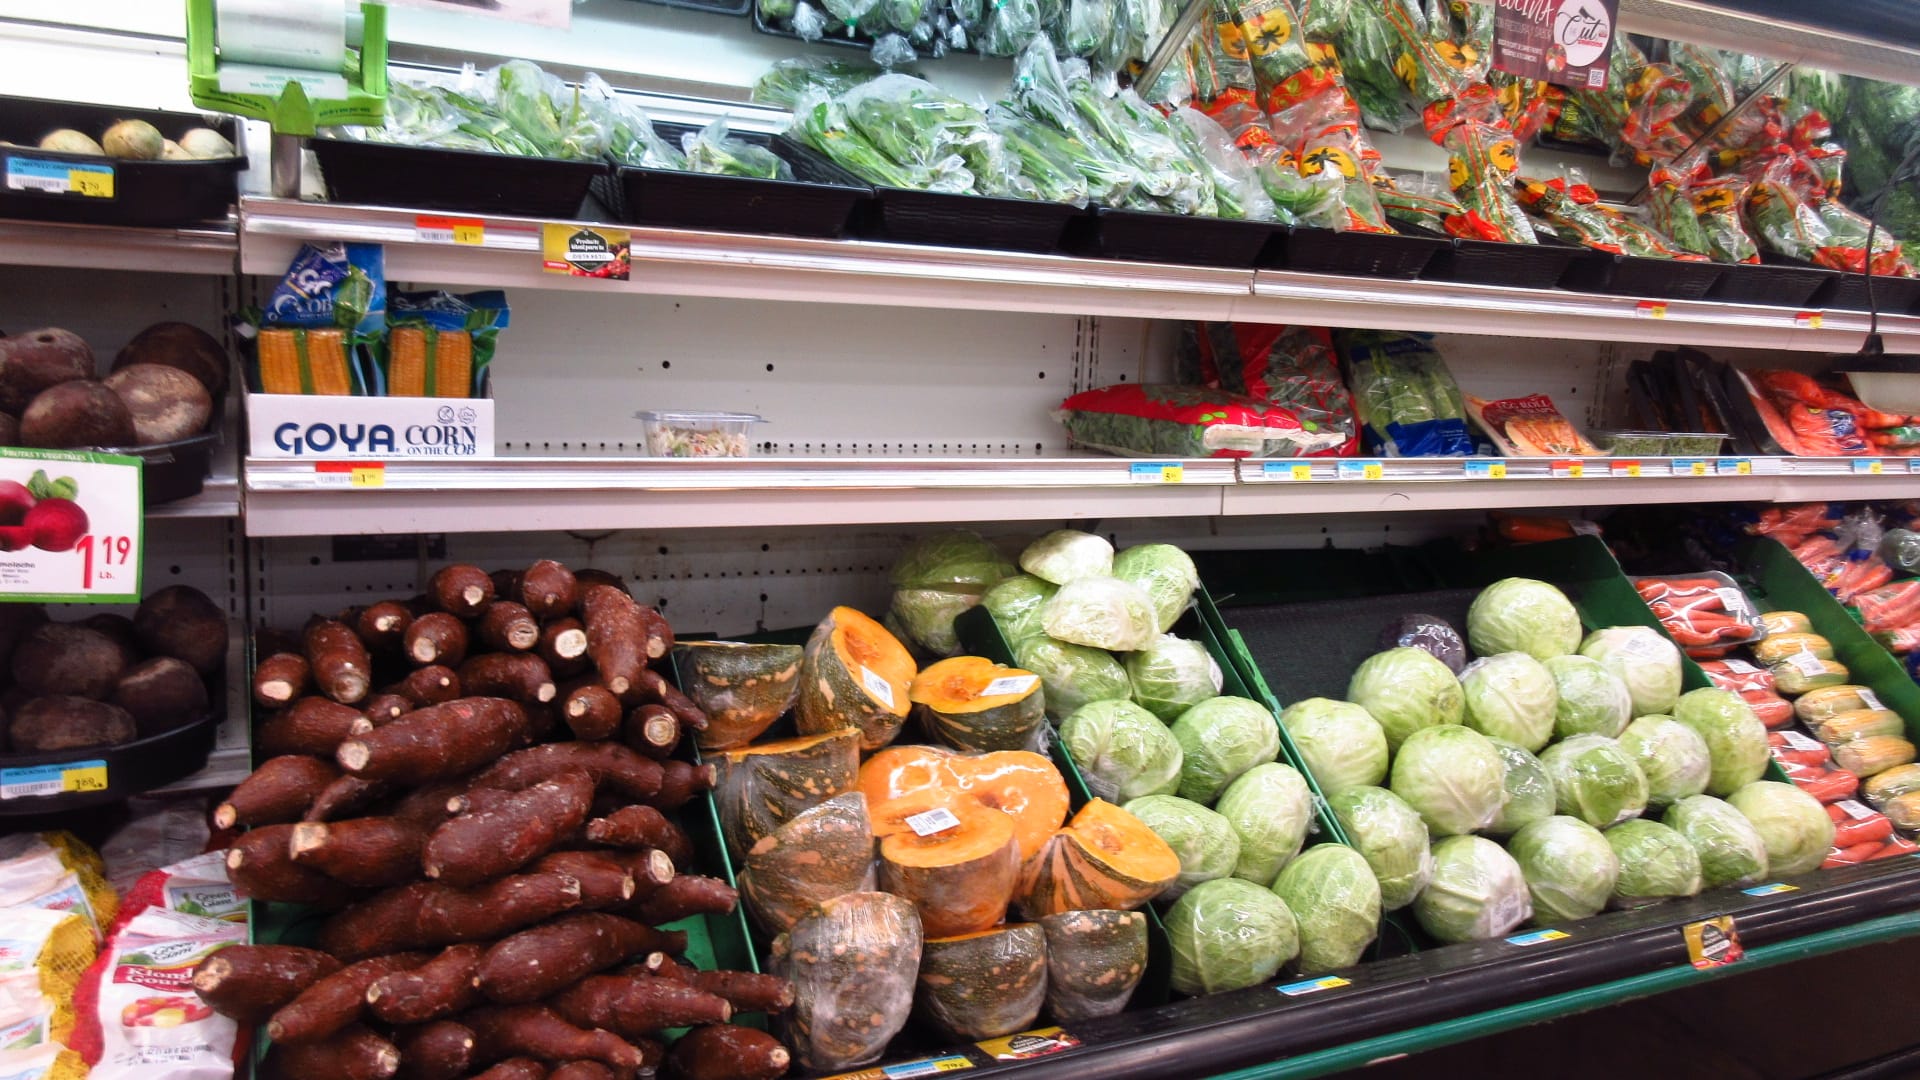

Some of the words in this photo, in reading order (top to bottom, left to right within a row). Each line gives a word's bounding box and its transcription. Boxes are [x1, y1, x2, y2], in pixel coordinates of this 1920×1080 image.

[1498, 0, 1554, 27] CINA
[1557, 12, 1607, 46] Cut
[274, 422, 395, 456] GOYA
[405, 424, 477, 447] CORN
[407, 446, 421, 456] ON
[424, 446, 443, 456] THE
[444, 444, 477, 456] COB
[76, 535, 95, 589] 1
[103, 536, 132, 565] 19
[99, 571, 115, 580] Lb.
[196, 891, 231, 901] Green
[202, 898, 232, 908] Giant
[128, 967, 194, 979] Klond
